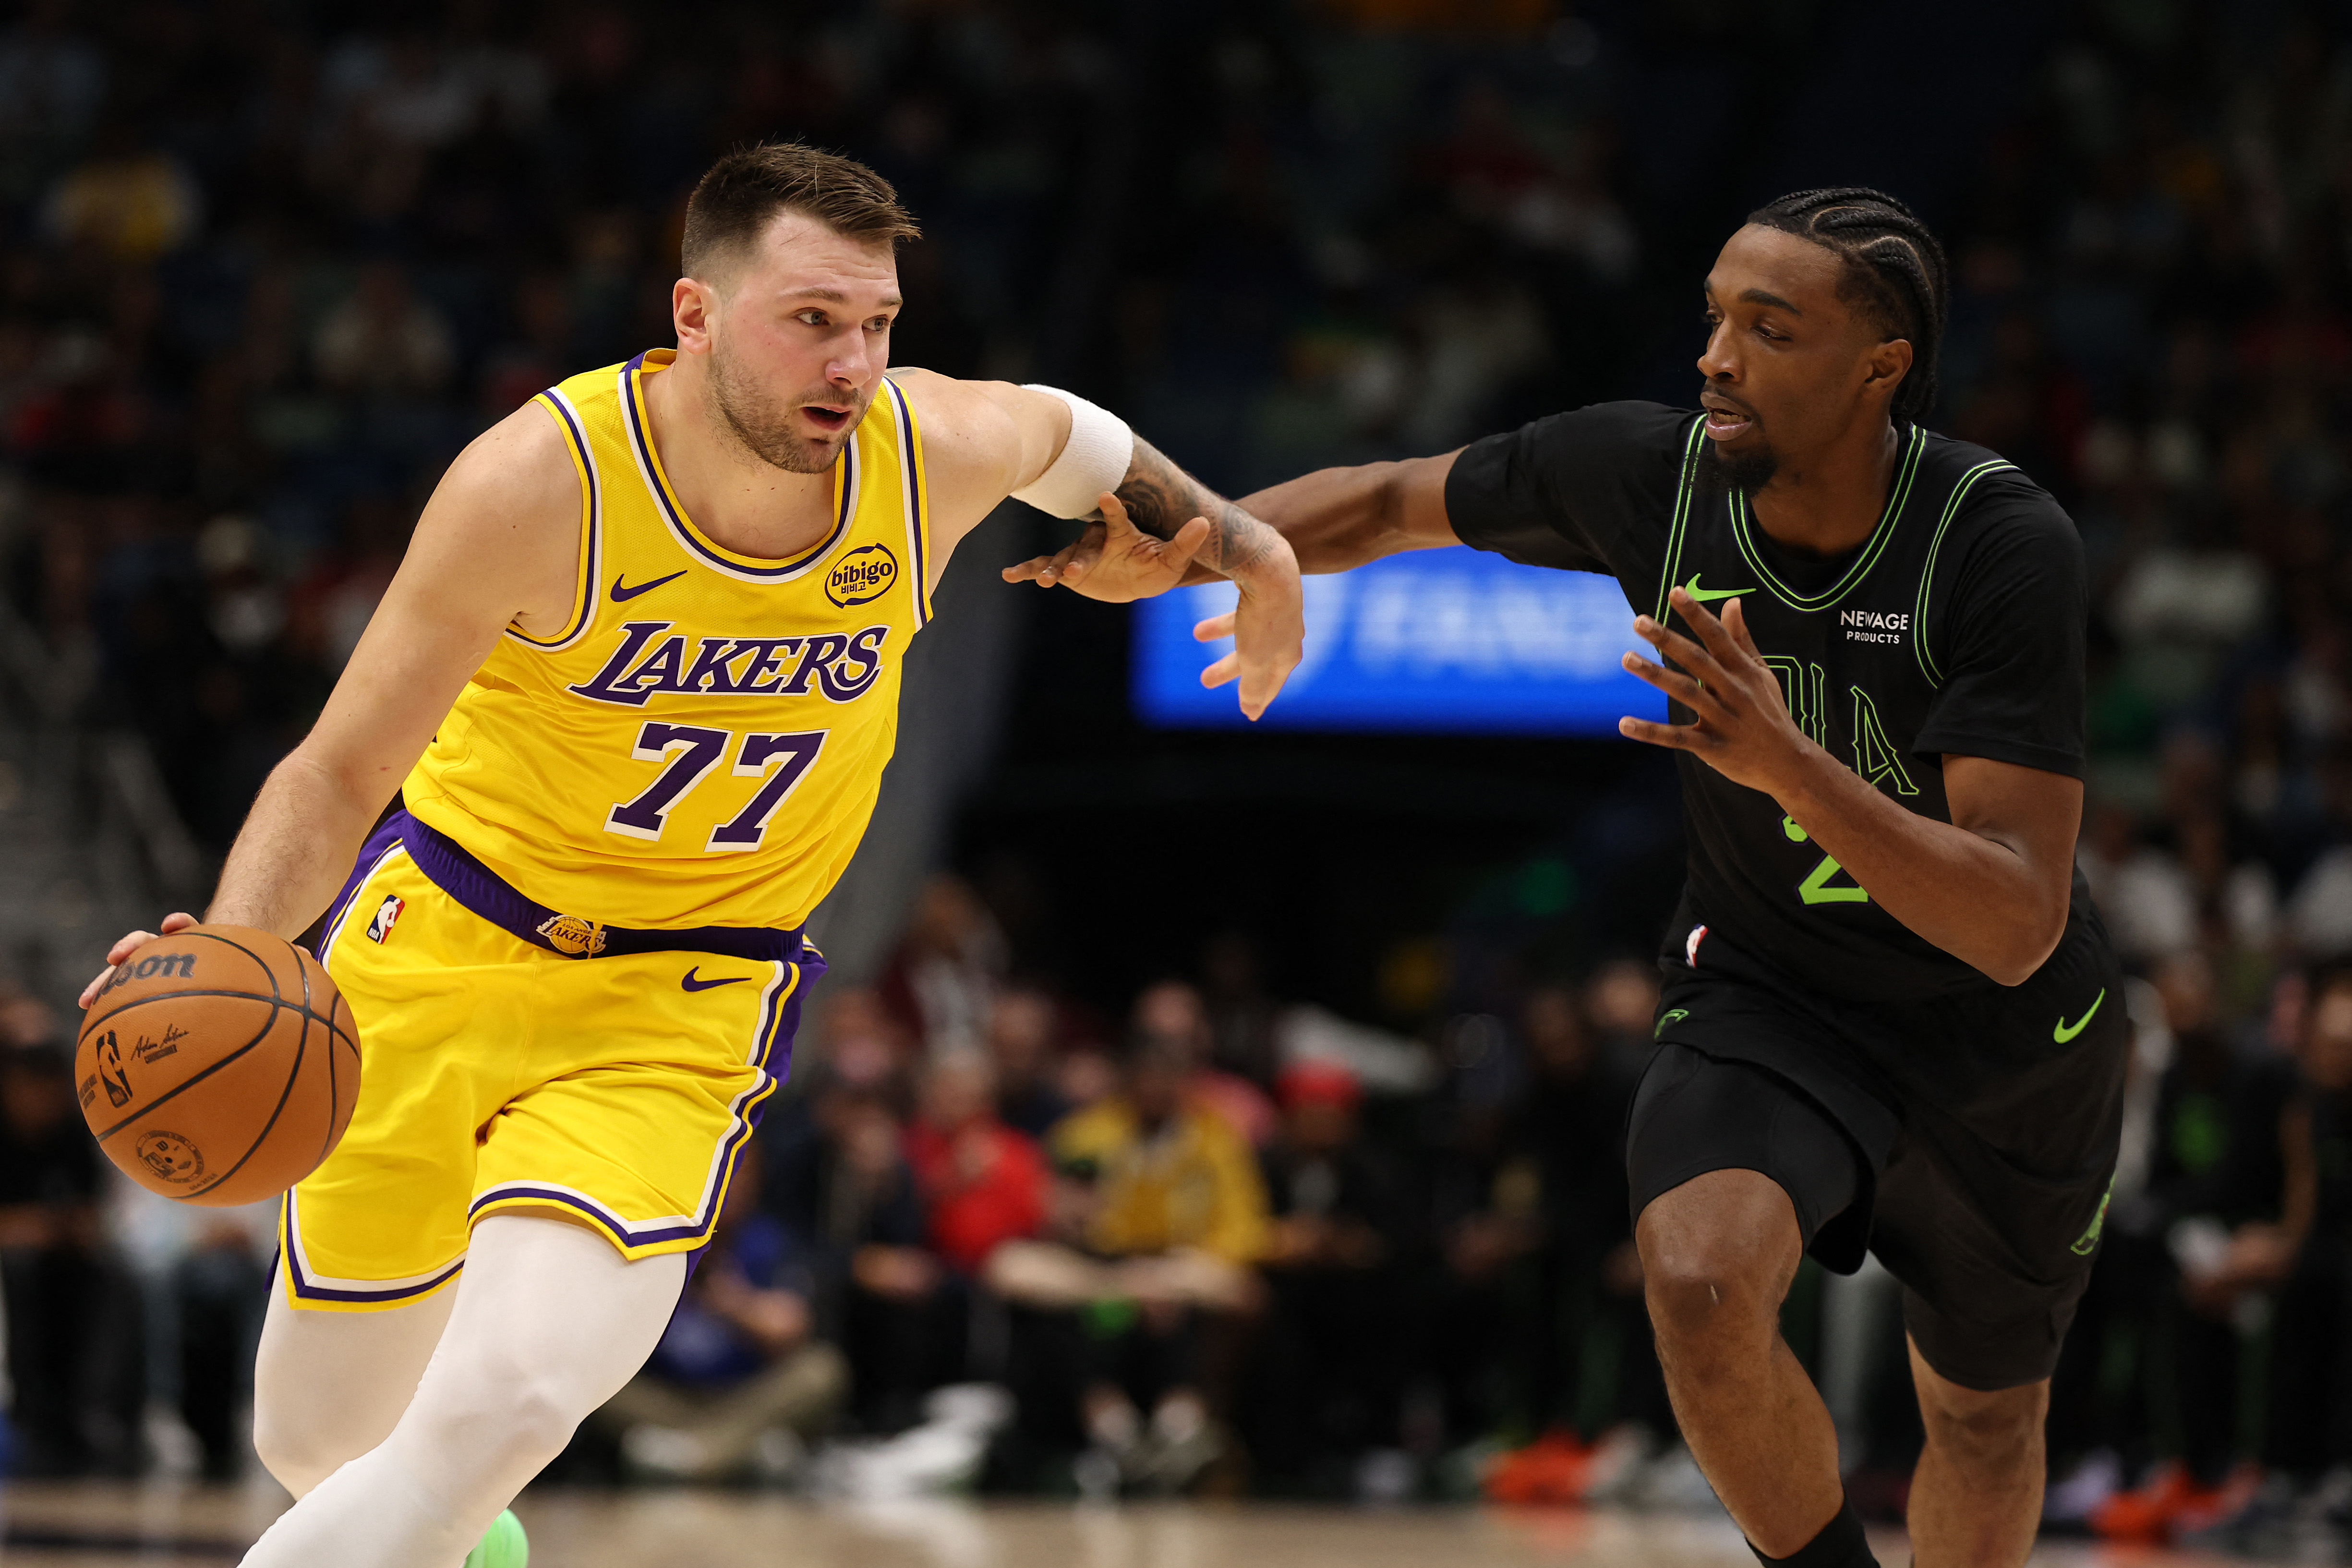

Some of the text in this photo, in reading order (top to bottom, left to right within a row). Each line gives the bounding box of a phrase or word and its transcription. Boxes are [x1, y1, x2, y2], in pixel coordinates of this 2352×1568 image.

[832, 561, 893, 587] bibigo
[841, 581, 866, 594] 비비고
[1840, 610, 1909, 630] NEWAGE
[1846, 631, 1900, 644] PRODUCTS
[565, 620, 891, 708] LAKERS
[603, 720, 831, 853] 77
[368, 927, 380, 941] NBA
